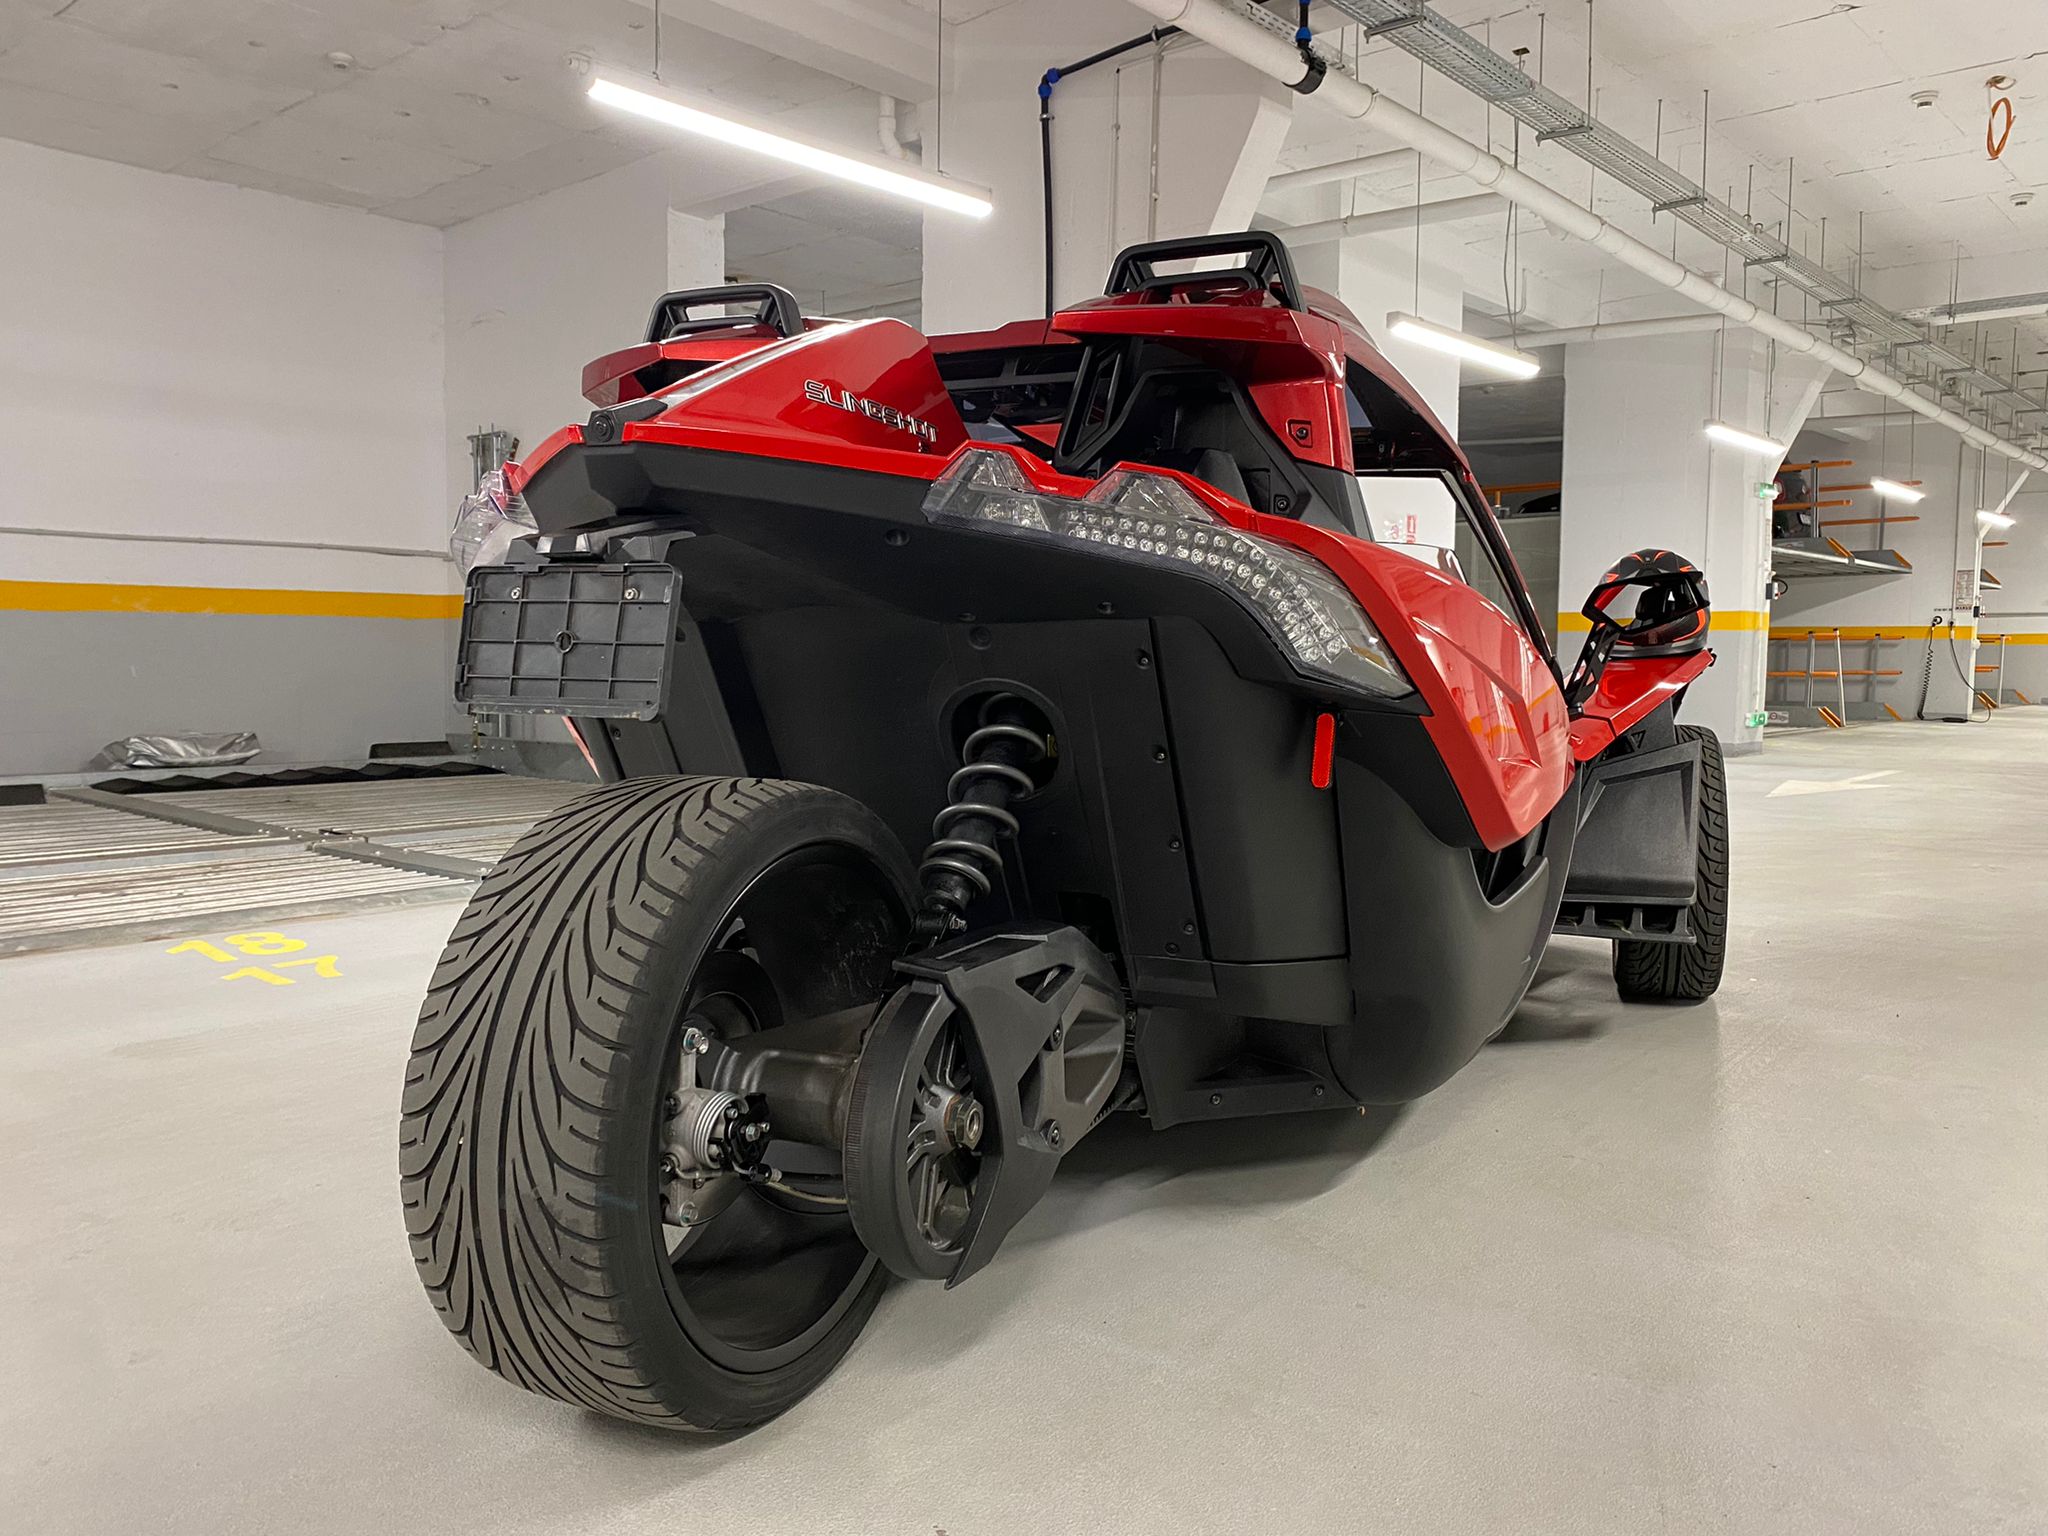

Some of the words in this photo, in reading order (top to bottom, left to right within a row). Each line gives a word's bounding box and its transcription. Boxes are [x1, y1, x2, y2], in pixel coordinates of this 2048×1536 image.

[804, 379, 938, 442] SLINGSHOT
[166, 931, 307, 962] 18
[221, 955, 343, 985] 17
